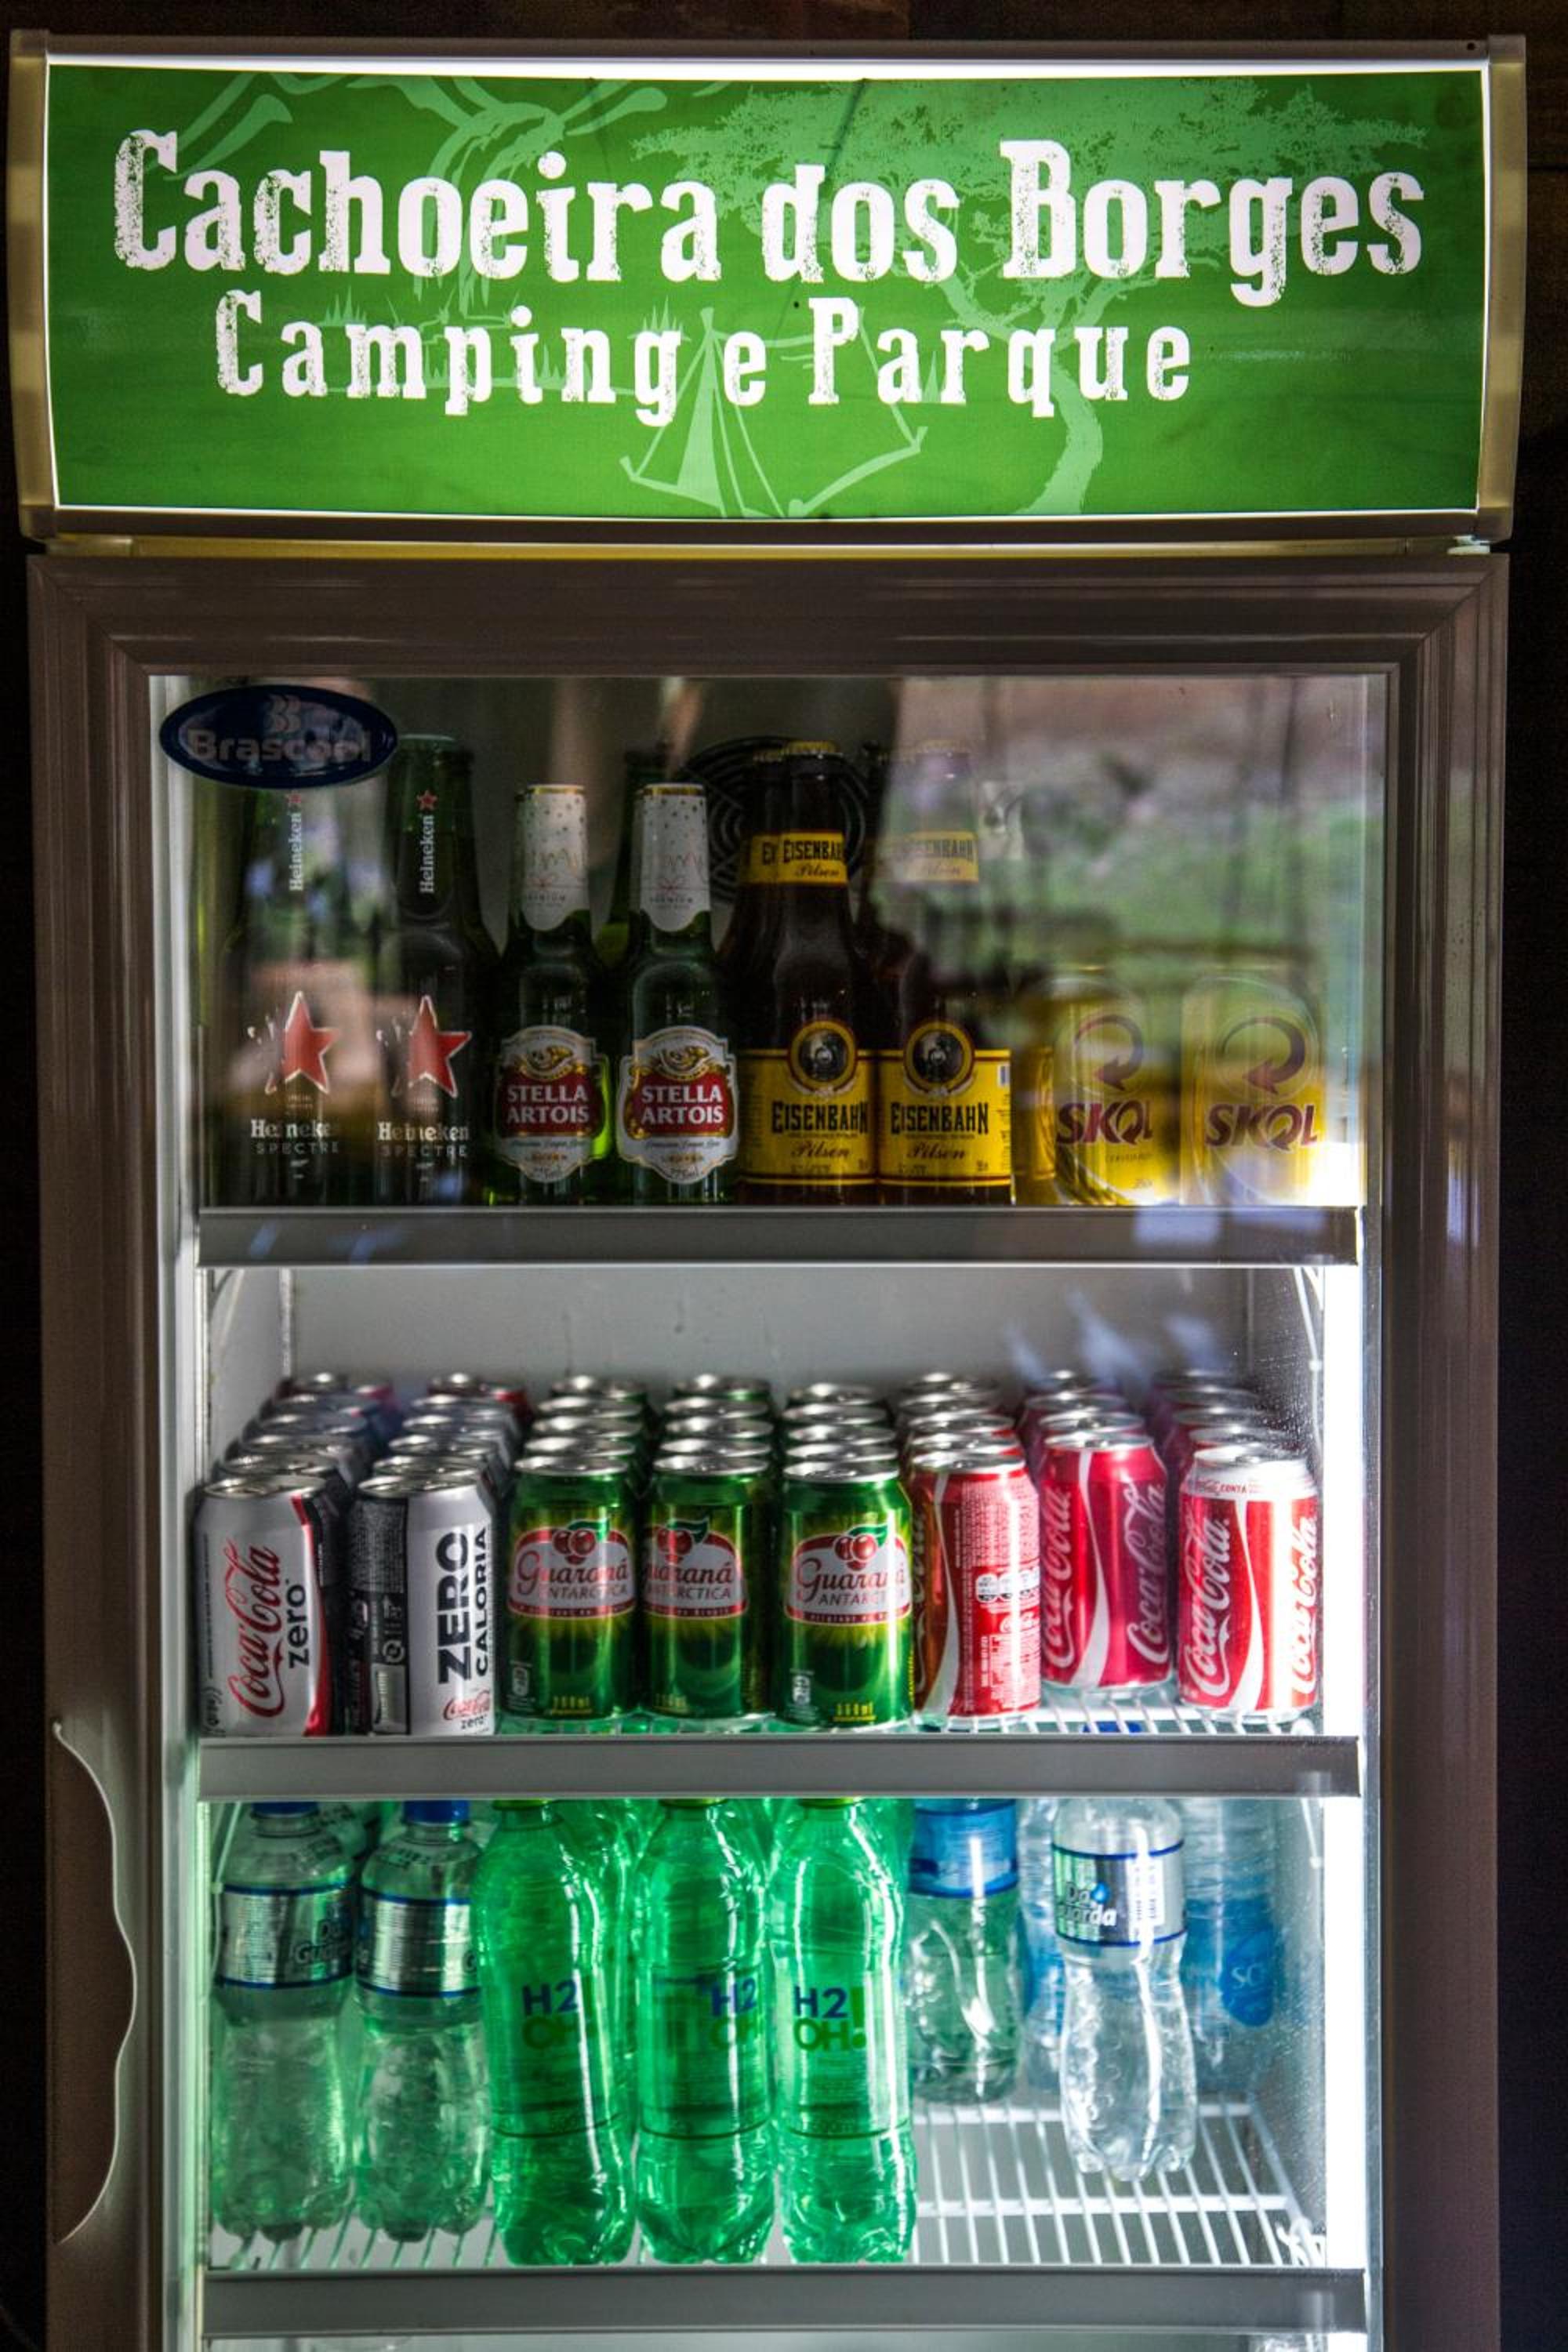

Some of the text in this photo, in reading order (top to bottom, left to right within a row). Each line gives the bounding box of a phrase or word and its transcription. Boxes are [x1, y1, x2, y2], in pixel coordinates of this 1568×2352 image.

[114, 129, 1425, 307] Cachoeira dos Borges
[216, 289, 1192, 427] Camping e Parque
[289, 811, 303, 891] Heineken
[419, 815, 436, 895] Heineken
[509, 1085, 588, 1103] STELLA
[641, 1085, 724, 1103] STELLA
[506, 1106, 590, 1123] ARTOIS
[640, 1106, 724, 1124] ARTOIS
[771, 1101, 869, 1134] EISENBAHN
[891, 1102, 989, 1135] EISENBAHN
[1057, 1102, 1153, 1145] SKOL
[1205, 1104, 1318, 1151] SKOL
[380, 1145, 468, 1158] SPECTRE
[790, 1141, 850, 1160] Pilsen
[906, 1141, 965, 1160] Pilsen
[646, 1559, 733, 1584] uaraná
[436, 1531, 472, 1685] ZERO
[474, 1529, 490, 1677] CALORIA
[286, 1584, 310, 1669] zero
[1055, 1904, 1118, 1927] arda
[522, 1979, 579, 2017] H2
[710, 1976, 757, 2017] H2
[794, 1986, 848, 2020] H2
